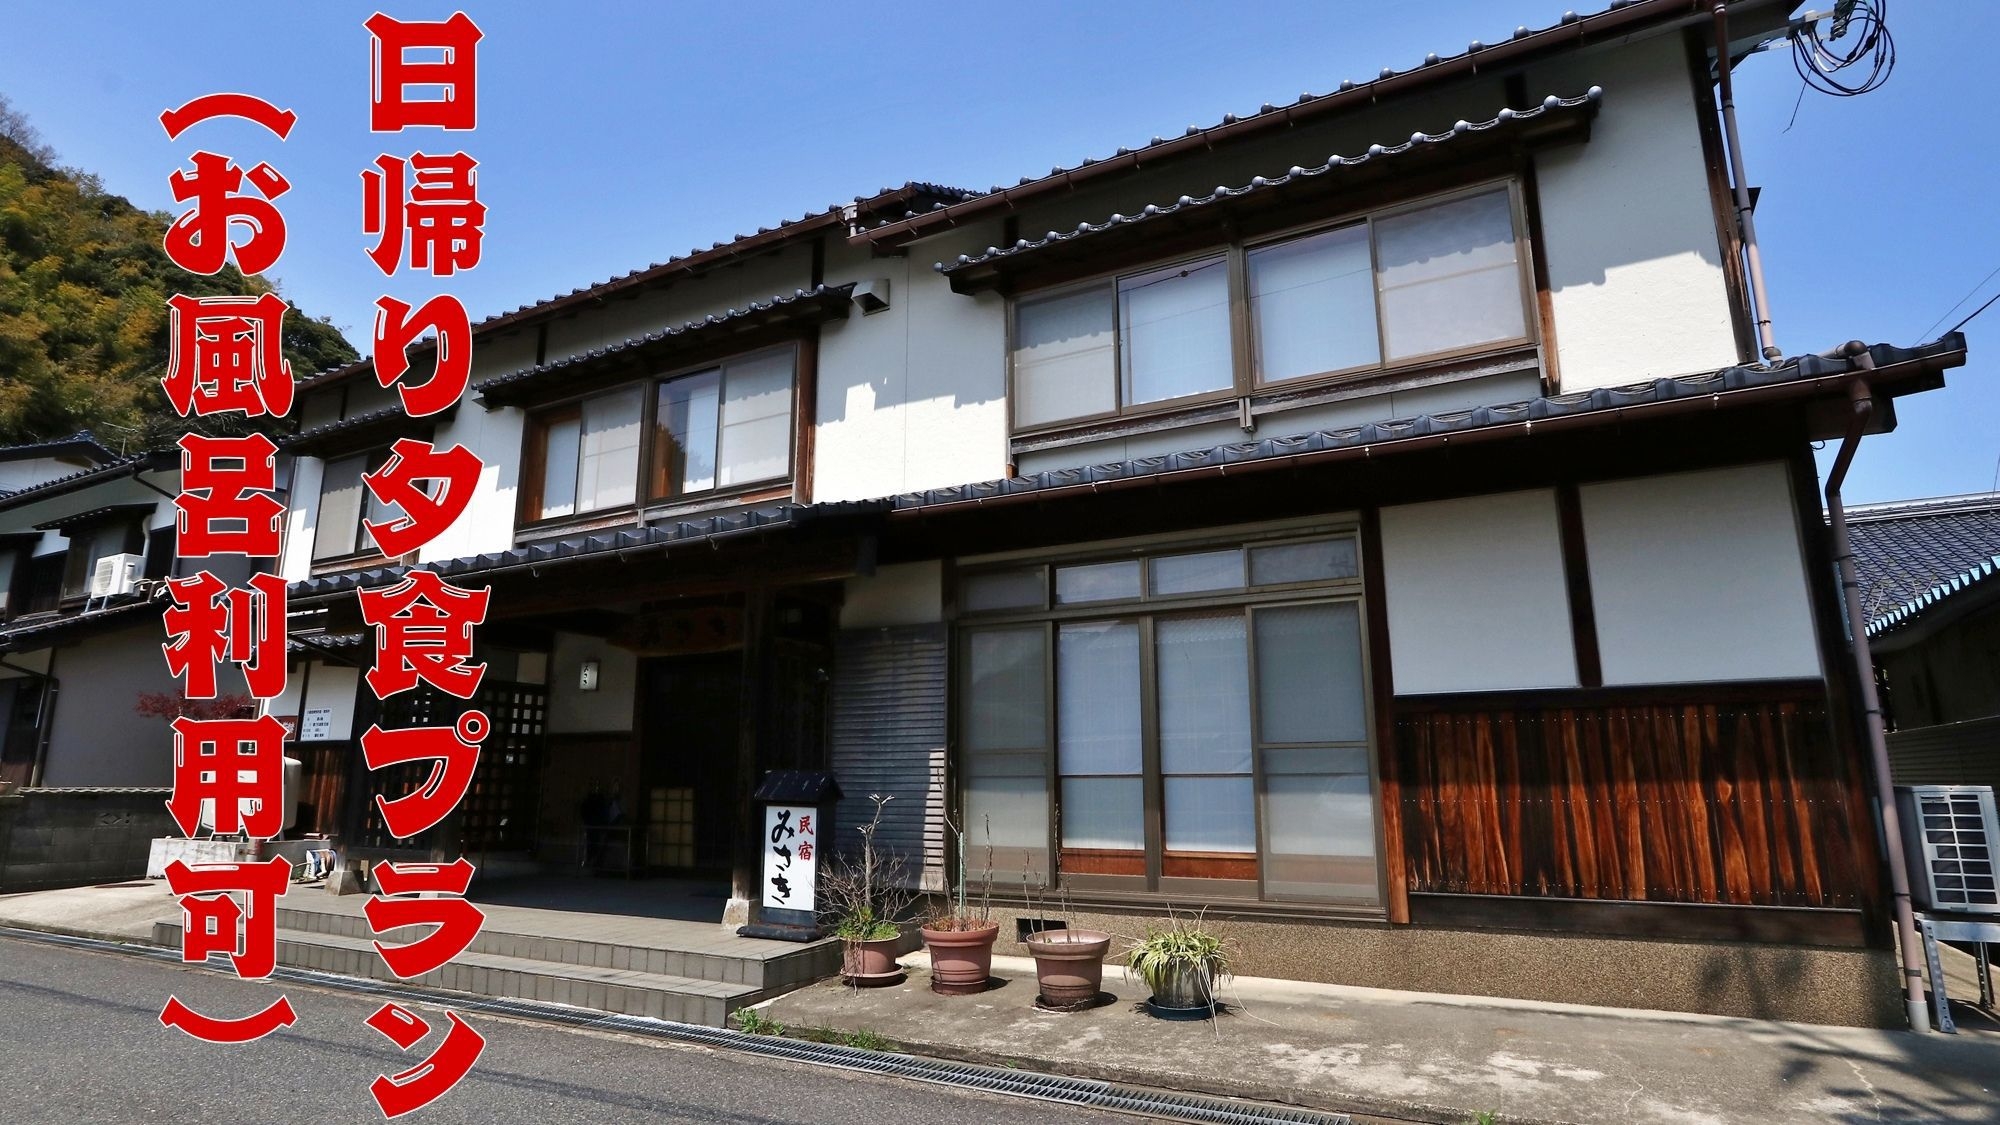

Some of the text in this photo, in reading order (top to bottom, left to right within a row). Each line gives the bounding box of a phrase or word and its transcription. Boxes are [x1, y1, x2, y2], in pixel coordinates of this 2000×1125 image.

[771, 809, 795, 905] みさき
[798, 815, 814, 861] 民宿
